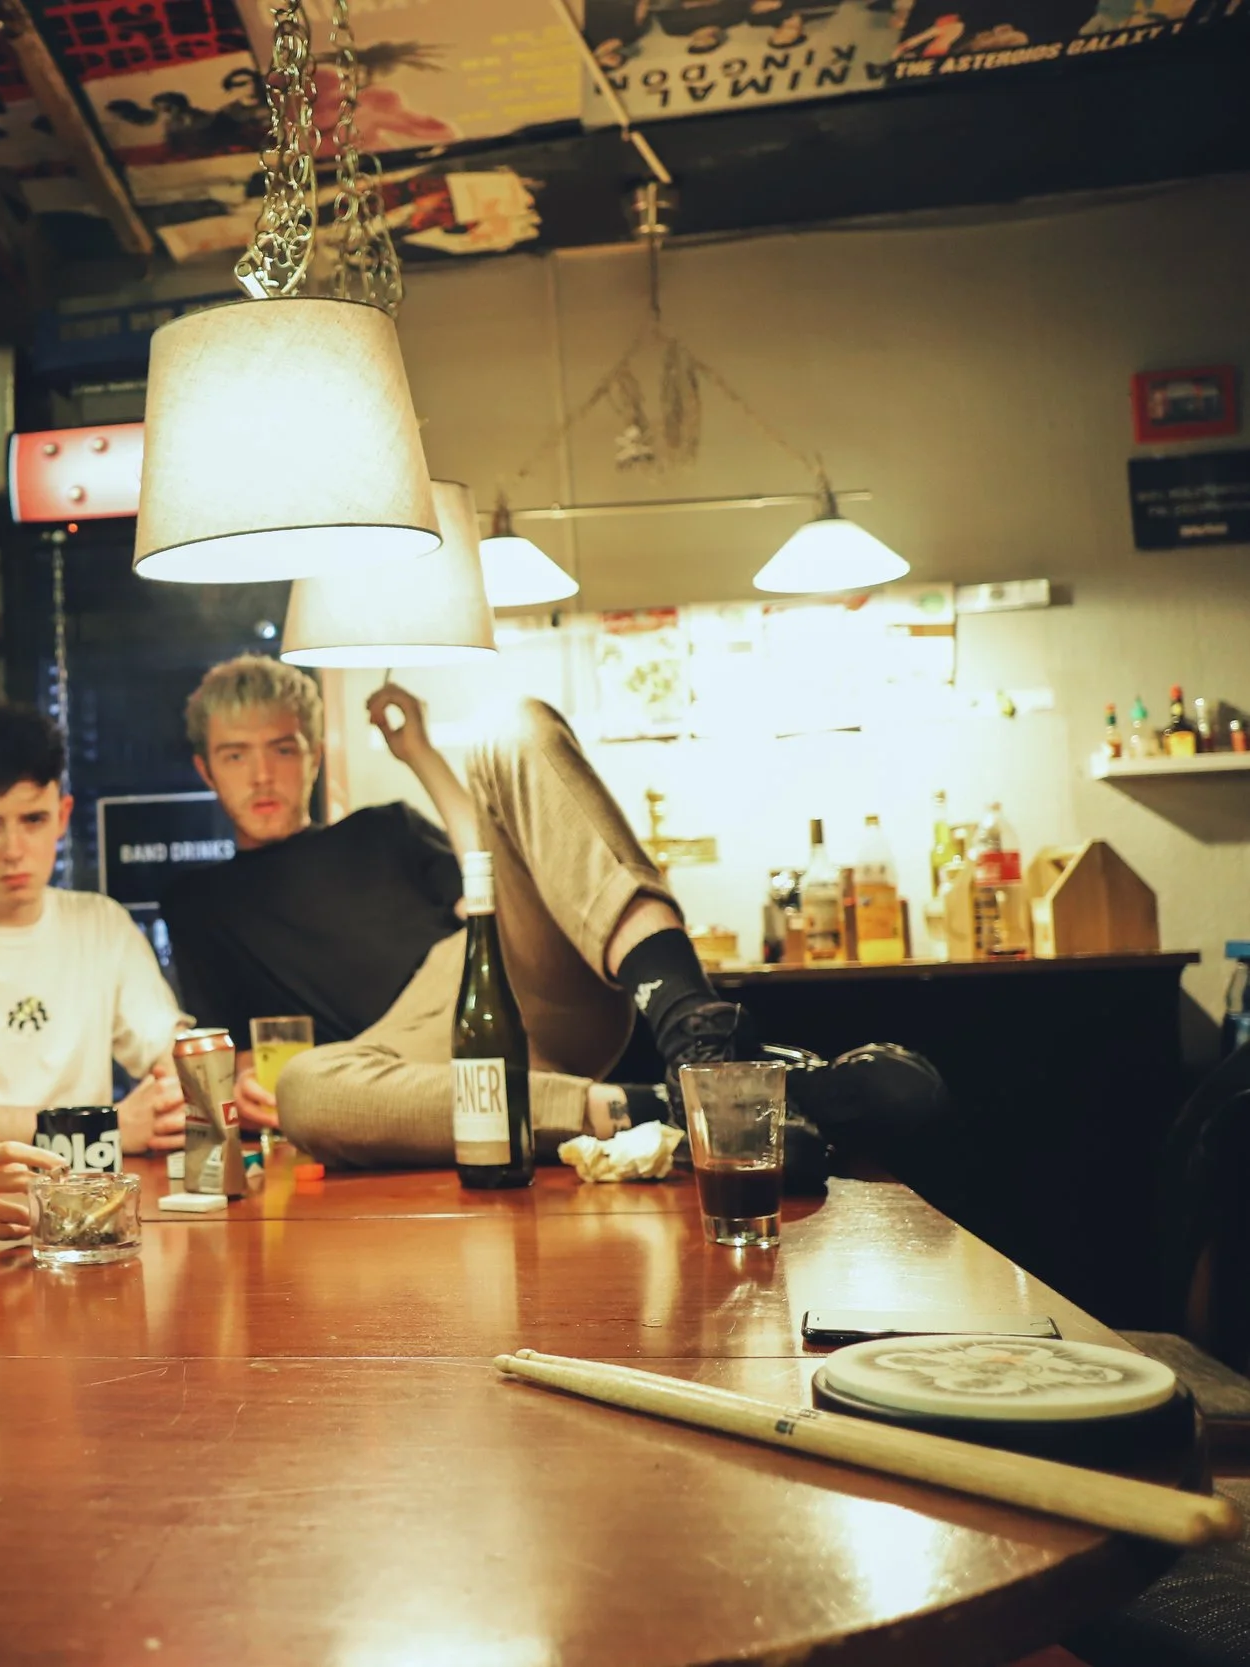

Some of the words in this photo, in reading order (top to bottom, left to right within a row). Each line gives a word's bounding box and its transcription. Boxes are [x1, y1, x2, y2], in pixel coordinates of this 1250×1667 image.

[594, 44, 857, 97] KINGDOM
[894, 57, 935, 80] THE
[939, 41, 1064, 75] ASTEROIDS
[1066, 25, 1162, 57] GALAXY
[648, 65, 887, 108] ANIMAL
[120, 843, 168, 865] BAND
[169, 838, 237, 863] DRINKS
